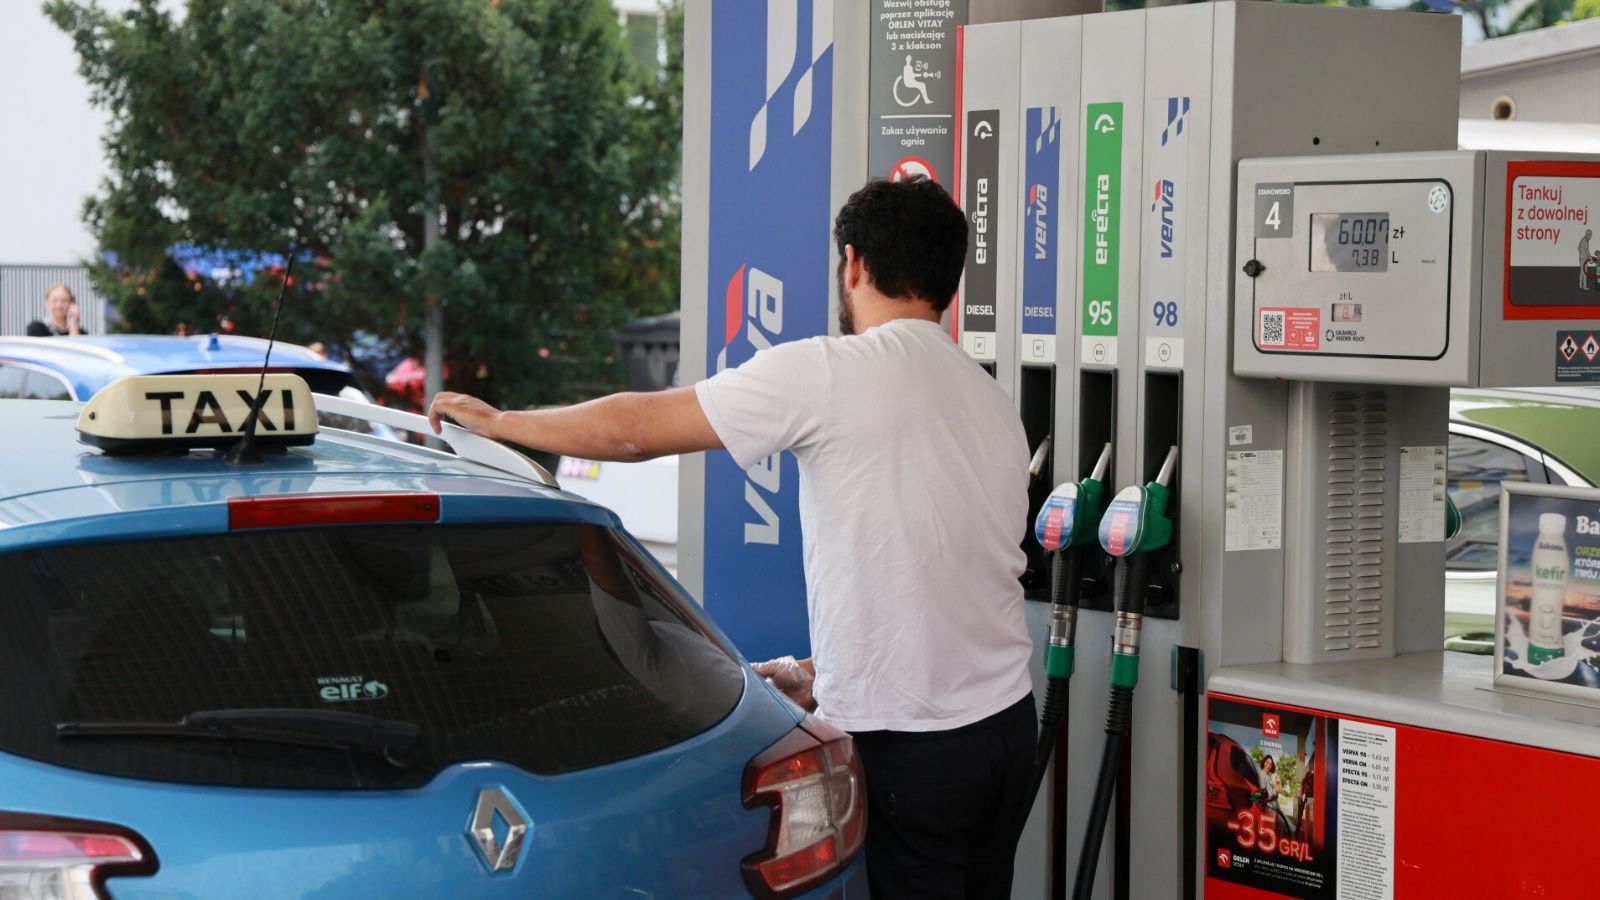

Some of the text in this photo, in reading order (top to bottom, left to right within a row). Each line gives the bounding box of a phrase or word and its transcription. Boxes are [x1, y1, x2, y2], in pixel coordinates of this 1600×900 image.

[884, 0, 912, 8] Wezwij
[880, 9, 954, 21] poprzez aplikację
[888, 21, 914, 29] ORLEN
[886, 30, 945, 40] lub naciskając
[906, 41, 941, 50] klakson
[881, 125, 947, 136] Zakaz używania
[901, 137, 925, 147] ognia
[1518, 185, 1562, 205] Tankuj
[1035, 184, 1048, 260] verva
[1161, 179, 1174, 258] verva
[1265, 201, 1280, 230] 4
[1518, 205, 1588, 225] z dowolnej
[1392, 226, 1405, 239] zł
[1517, 225, 1560, 244] strony
[1392, 251, 1399, 263] L
[966, 304, 994, 315] DIESEL
[1024, 306, 1054, 318] DIESEL
[1088, 300, 1112, 326] 95
[1153, 301, 1178, 326] 98
[145, 390, 295, 434] TAXI
[744, 267, 784, 545] vea
[1536, 564, 1565, 580] kefir
[317, 676, 363, 684] RENAULT
[320, 683, 362, 700] elf
[1228, 811, 1313, 862] -35 GR/L
